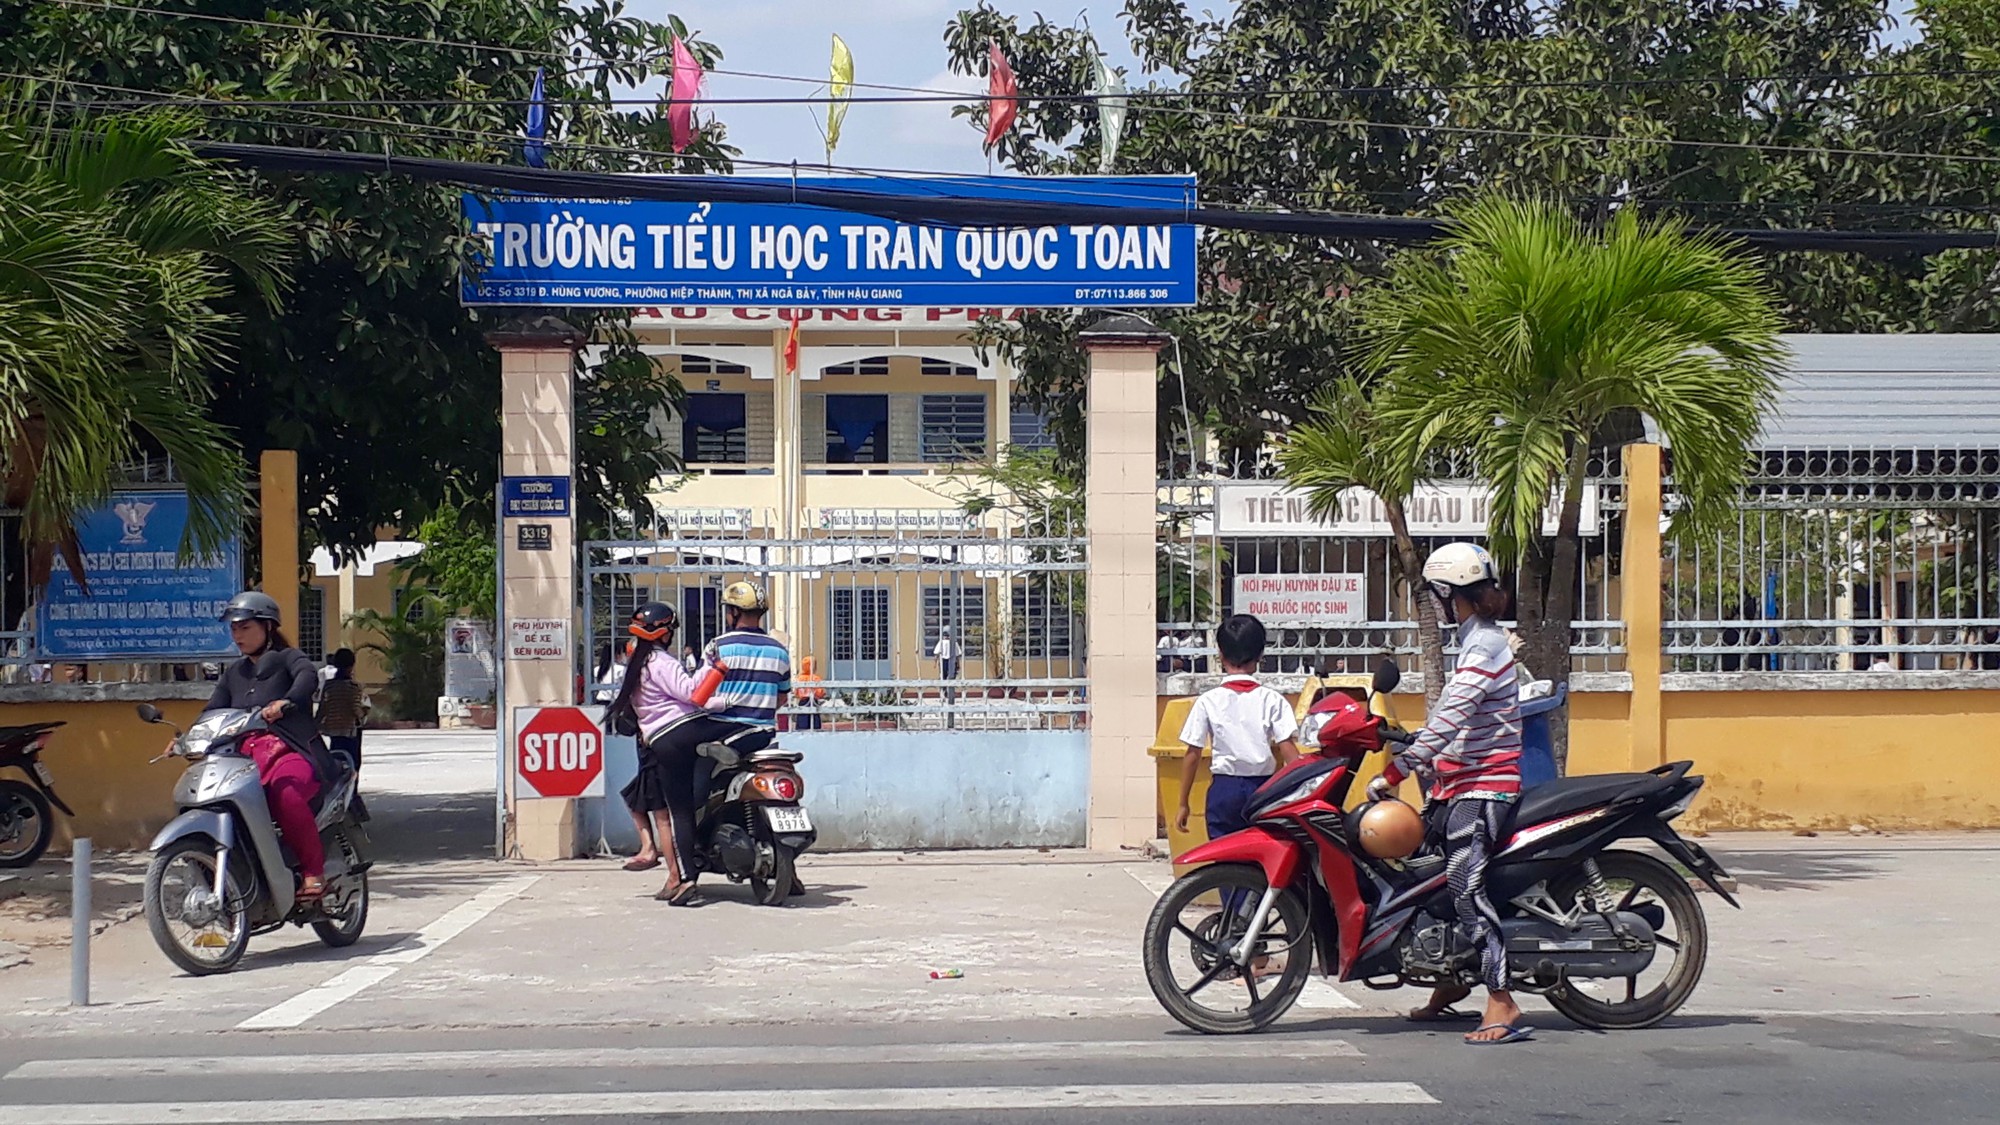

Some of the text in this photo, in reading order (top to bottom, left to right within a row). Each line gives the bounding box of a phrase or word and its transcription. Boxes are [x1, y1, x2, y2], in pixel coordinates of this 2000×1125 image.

[477, 210, 636, 269] TRƯỜNG
[647, 202, 736, 270] TIỂU
[751, 225, 829, 279] HỌC
[514, 286, 537, 298] 3319
[539, 286, 549, 298] Đ.
[552, 285, 581, 298] HÙNG
[584, 286, 622, 299] VƯƠNG,
[625, 286, 668, 299] PHƯỜNG
[671, 286, 694, 300] HIỆP
[697, 287, 734, 300] THÀNH,
[737, 289, 753, 300] THỊ
[755, 287, 769, 299] XÃ
[771, 287, 794, 299] NGÃ
[796, 286, 820, 300] BẢY,
[822, 287, 845, 299] TỈNH
[847, 287, 869, 300] HẬU
[871, 288, 903, 299] GIANG
[1150, 289, 1169, 299] 306
[1411, 491, 1462, 528] HẬU
[521, 527, 548, 539] 3319
[1262, 579, 1282, 595] PHỤ
[1285, 579, 1319, 592] HUYNH
[1321, 576, 1341, 595] ĐẬU
[1345, 579, 1358, 592] XE
[1249, 600, 1269, 614] ĐƯA
[1301, 601, 1321, 617] HỌC
[1324, 601, 1348, 614] SINH
[540, 634, 552, 642] XE
[525, 732, 597, 773] STOP
[778, 819, 807, 830] 8978
